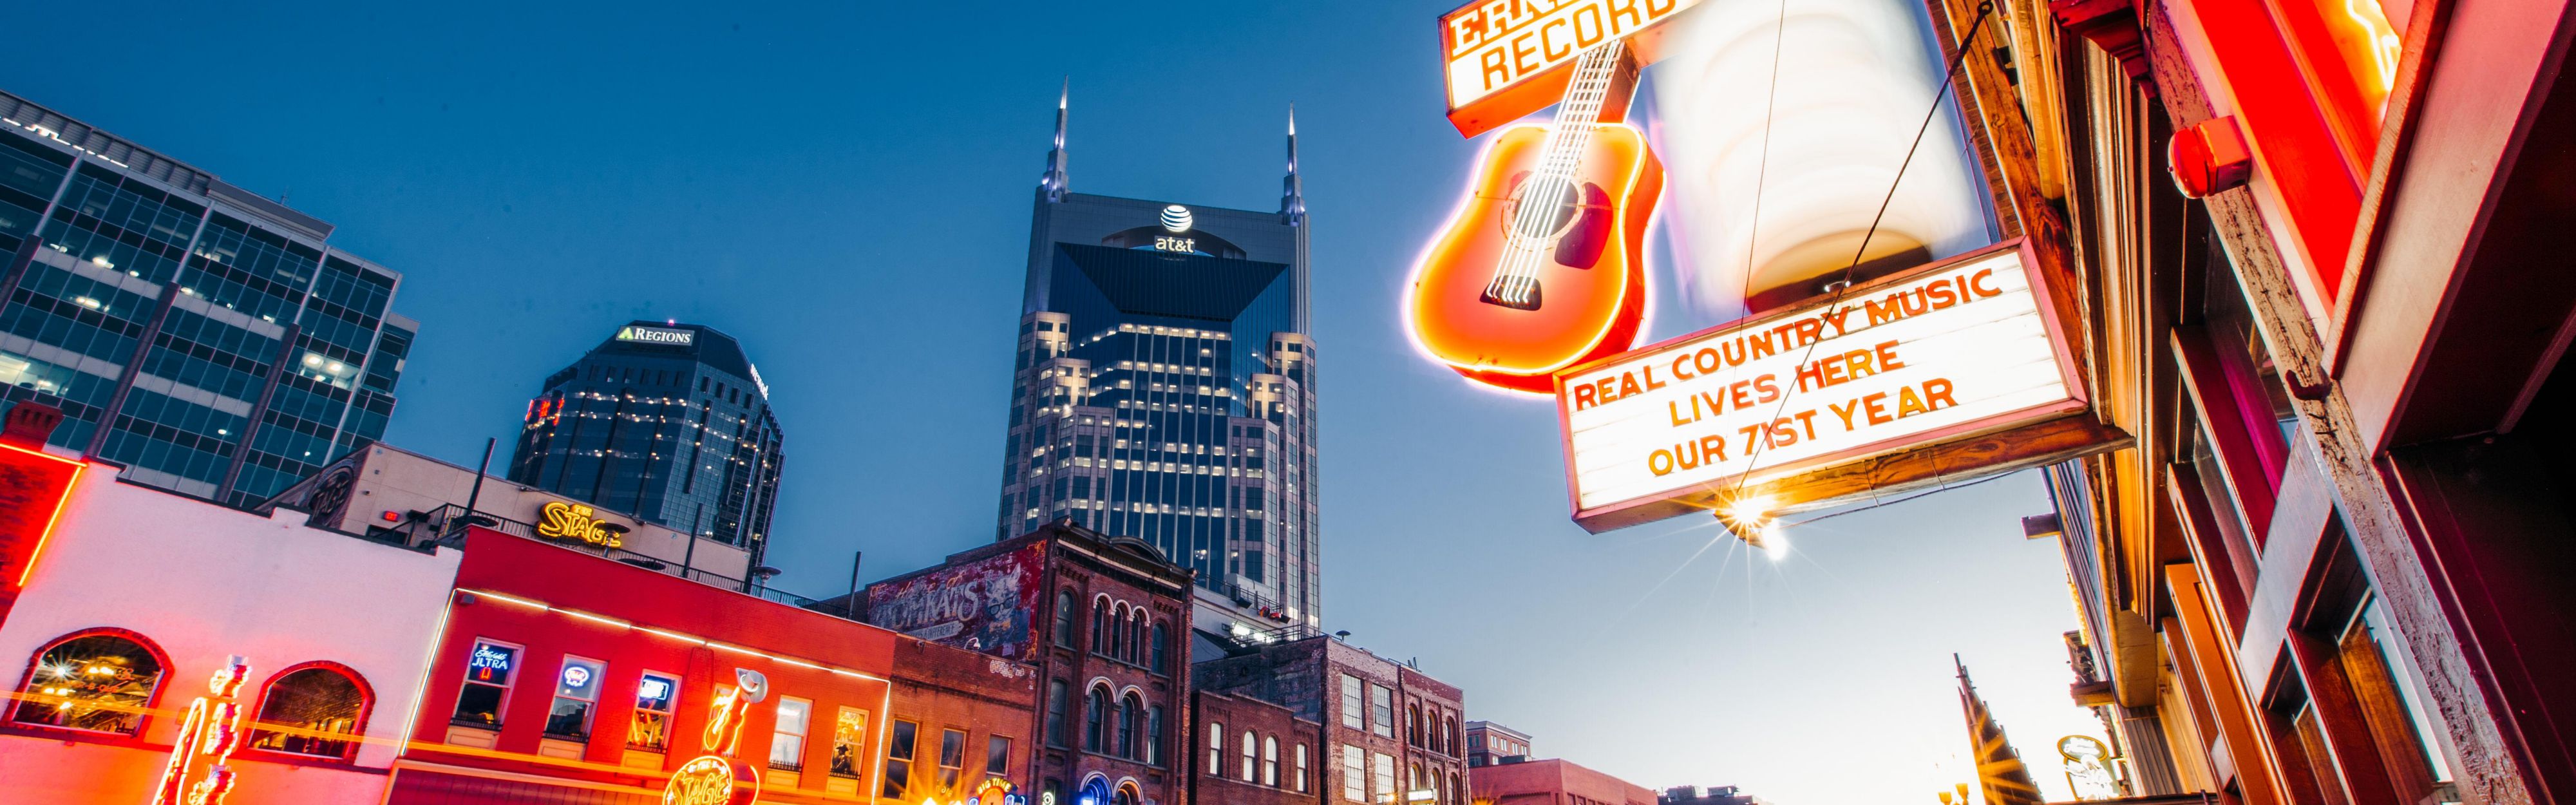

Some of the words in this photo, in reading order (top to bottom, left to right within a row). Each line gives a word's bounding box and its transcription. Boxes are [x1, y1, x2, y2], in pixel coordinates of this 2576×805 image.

[1155, 236, 1195, 252] at&t
[1574, 365, 1666, 412] REAL
[1672, 307, 1852, 381] COUNTRY
[1864, 268, 2003, 327] MUSIC
[1669, 374, 1781, 428] LIVES
[1795, 339, 1906, 394] HERE
[1648, 434, 1728, 477] OUR
[1738, 409, 1817, 456] 71ST
[1828, 378, 1959, 432] YEAR
[670, 772, 727, 805] STAGE
[978, 780, 991, 794] BIG
[992, 777, 1011, 793] TIME
